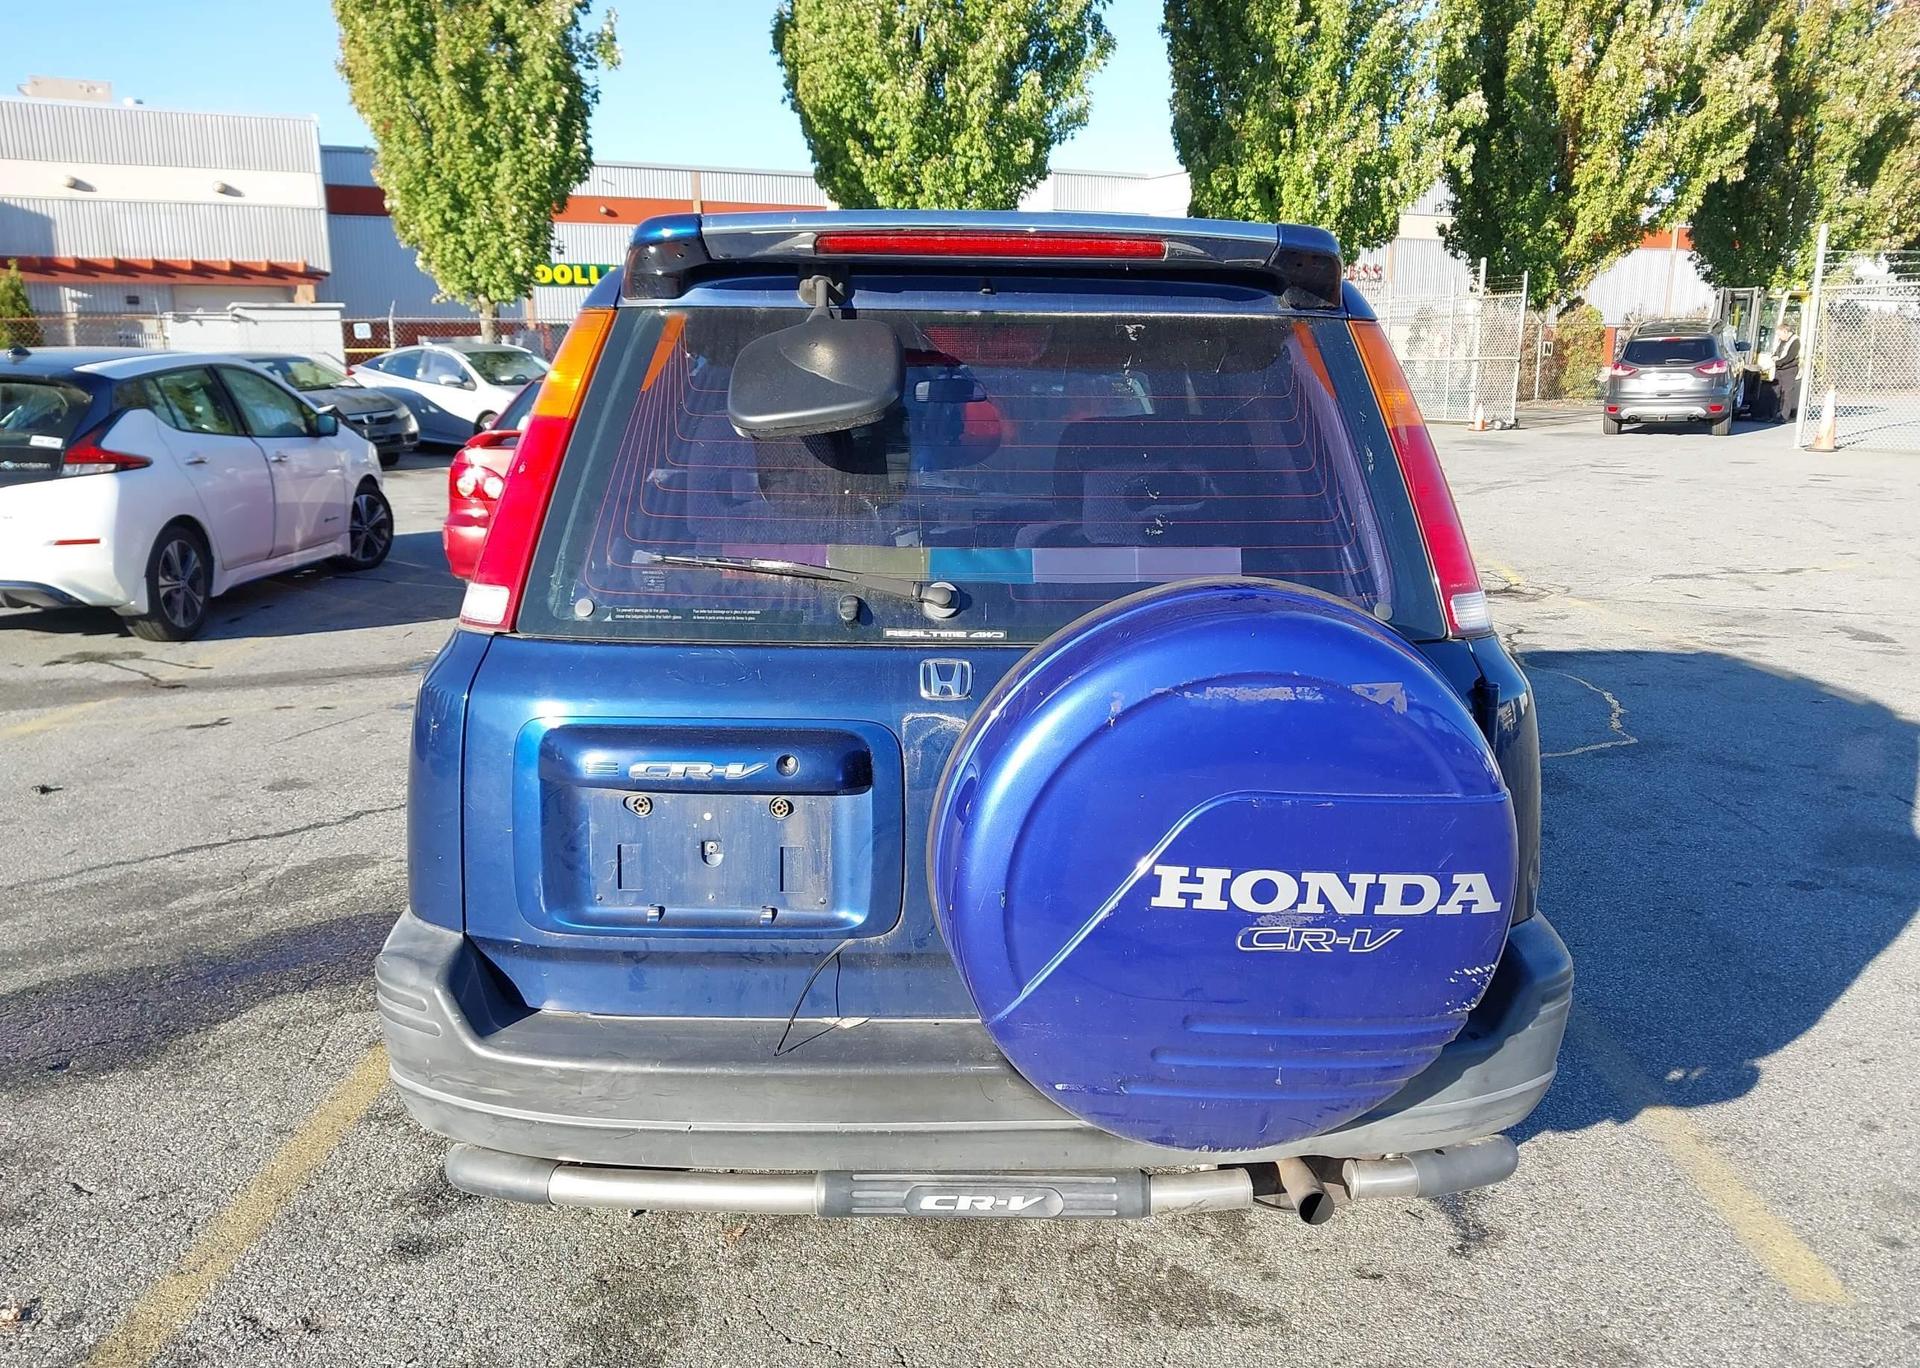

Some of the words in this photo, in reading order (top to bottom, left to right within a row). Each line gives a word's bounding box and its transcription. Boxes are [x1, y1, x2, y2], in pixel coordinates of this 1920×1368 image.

[535, 264, 616, 285] DOLL
[628, 762, 768, 780] CR-V
[1150, 865, 1501, 915] HONDA
[1235, 927, 1402, 952] CR-V
[919, 1195, 1047, 1211] CR-V
